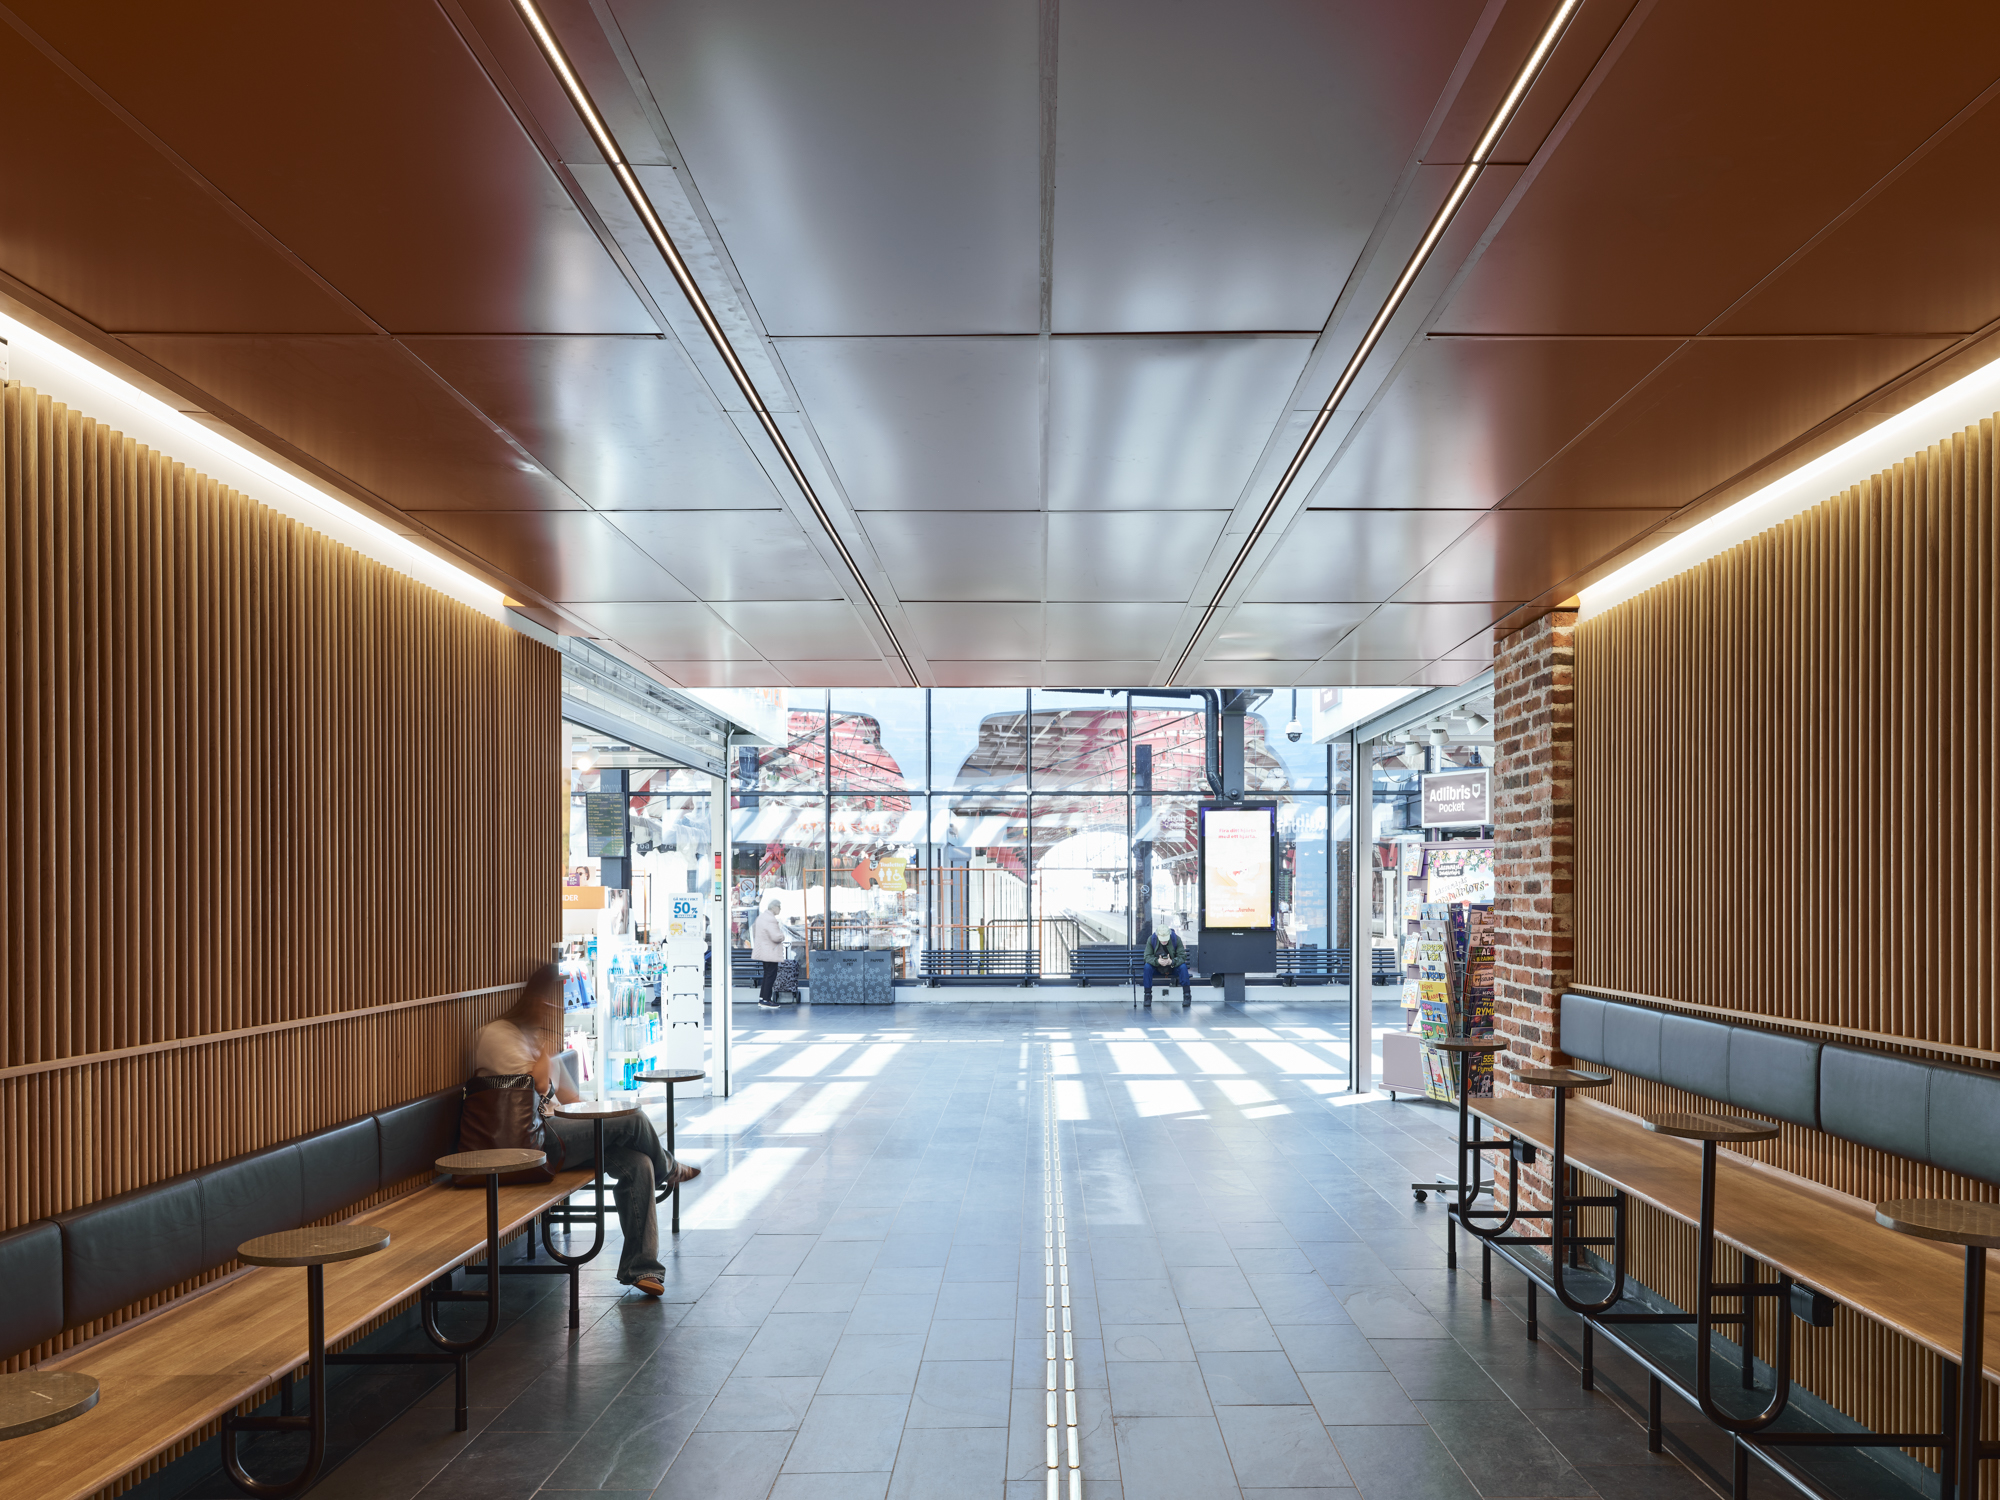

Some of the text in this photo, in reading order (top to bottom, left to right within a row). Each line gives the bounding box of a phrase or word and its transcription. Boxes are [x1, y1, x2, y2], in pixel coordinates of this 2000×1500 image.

[1429, 784, 1471, 802] Adlibris
[1438, 801, 1465, 813] Pocket
[673, 902, 698, 914] 50%
